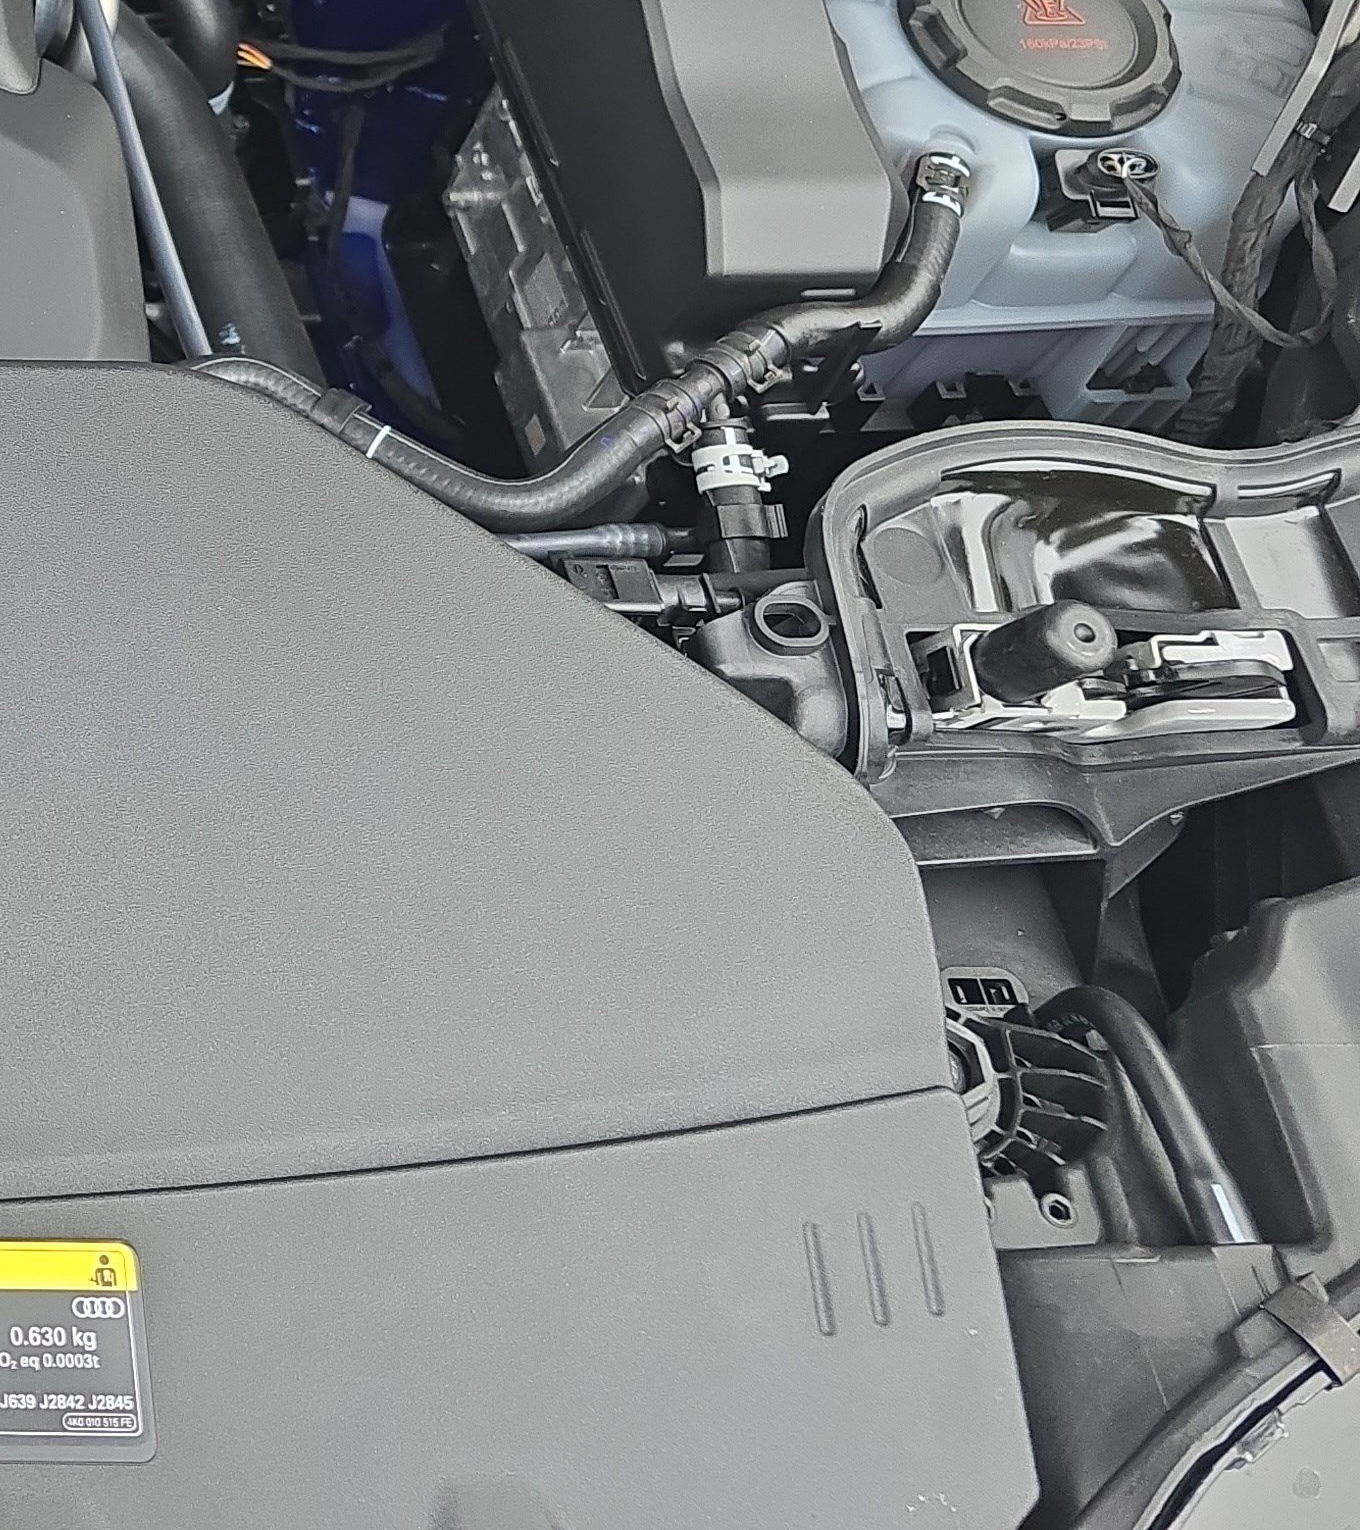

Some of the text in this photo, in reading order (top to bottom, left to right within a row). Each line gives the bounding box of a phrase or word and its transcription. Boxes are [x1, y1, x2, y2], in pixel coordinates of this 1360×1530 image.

[10, 1326, 98, 1351] 0.630 kg
[21, 1356, 40, 1372] eq
[43, 1353, 101, 1370] 0.0003t
[0, 1393, 36, 1410] J639
[40, 1393, 85, 1410] J2842
[88, 1394, 135, 1411] J2845
[103, 1417, 119, 1427] 515
